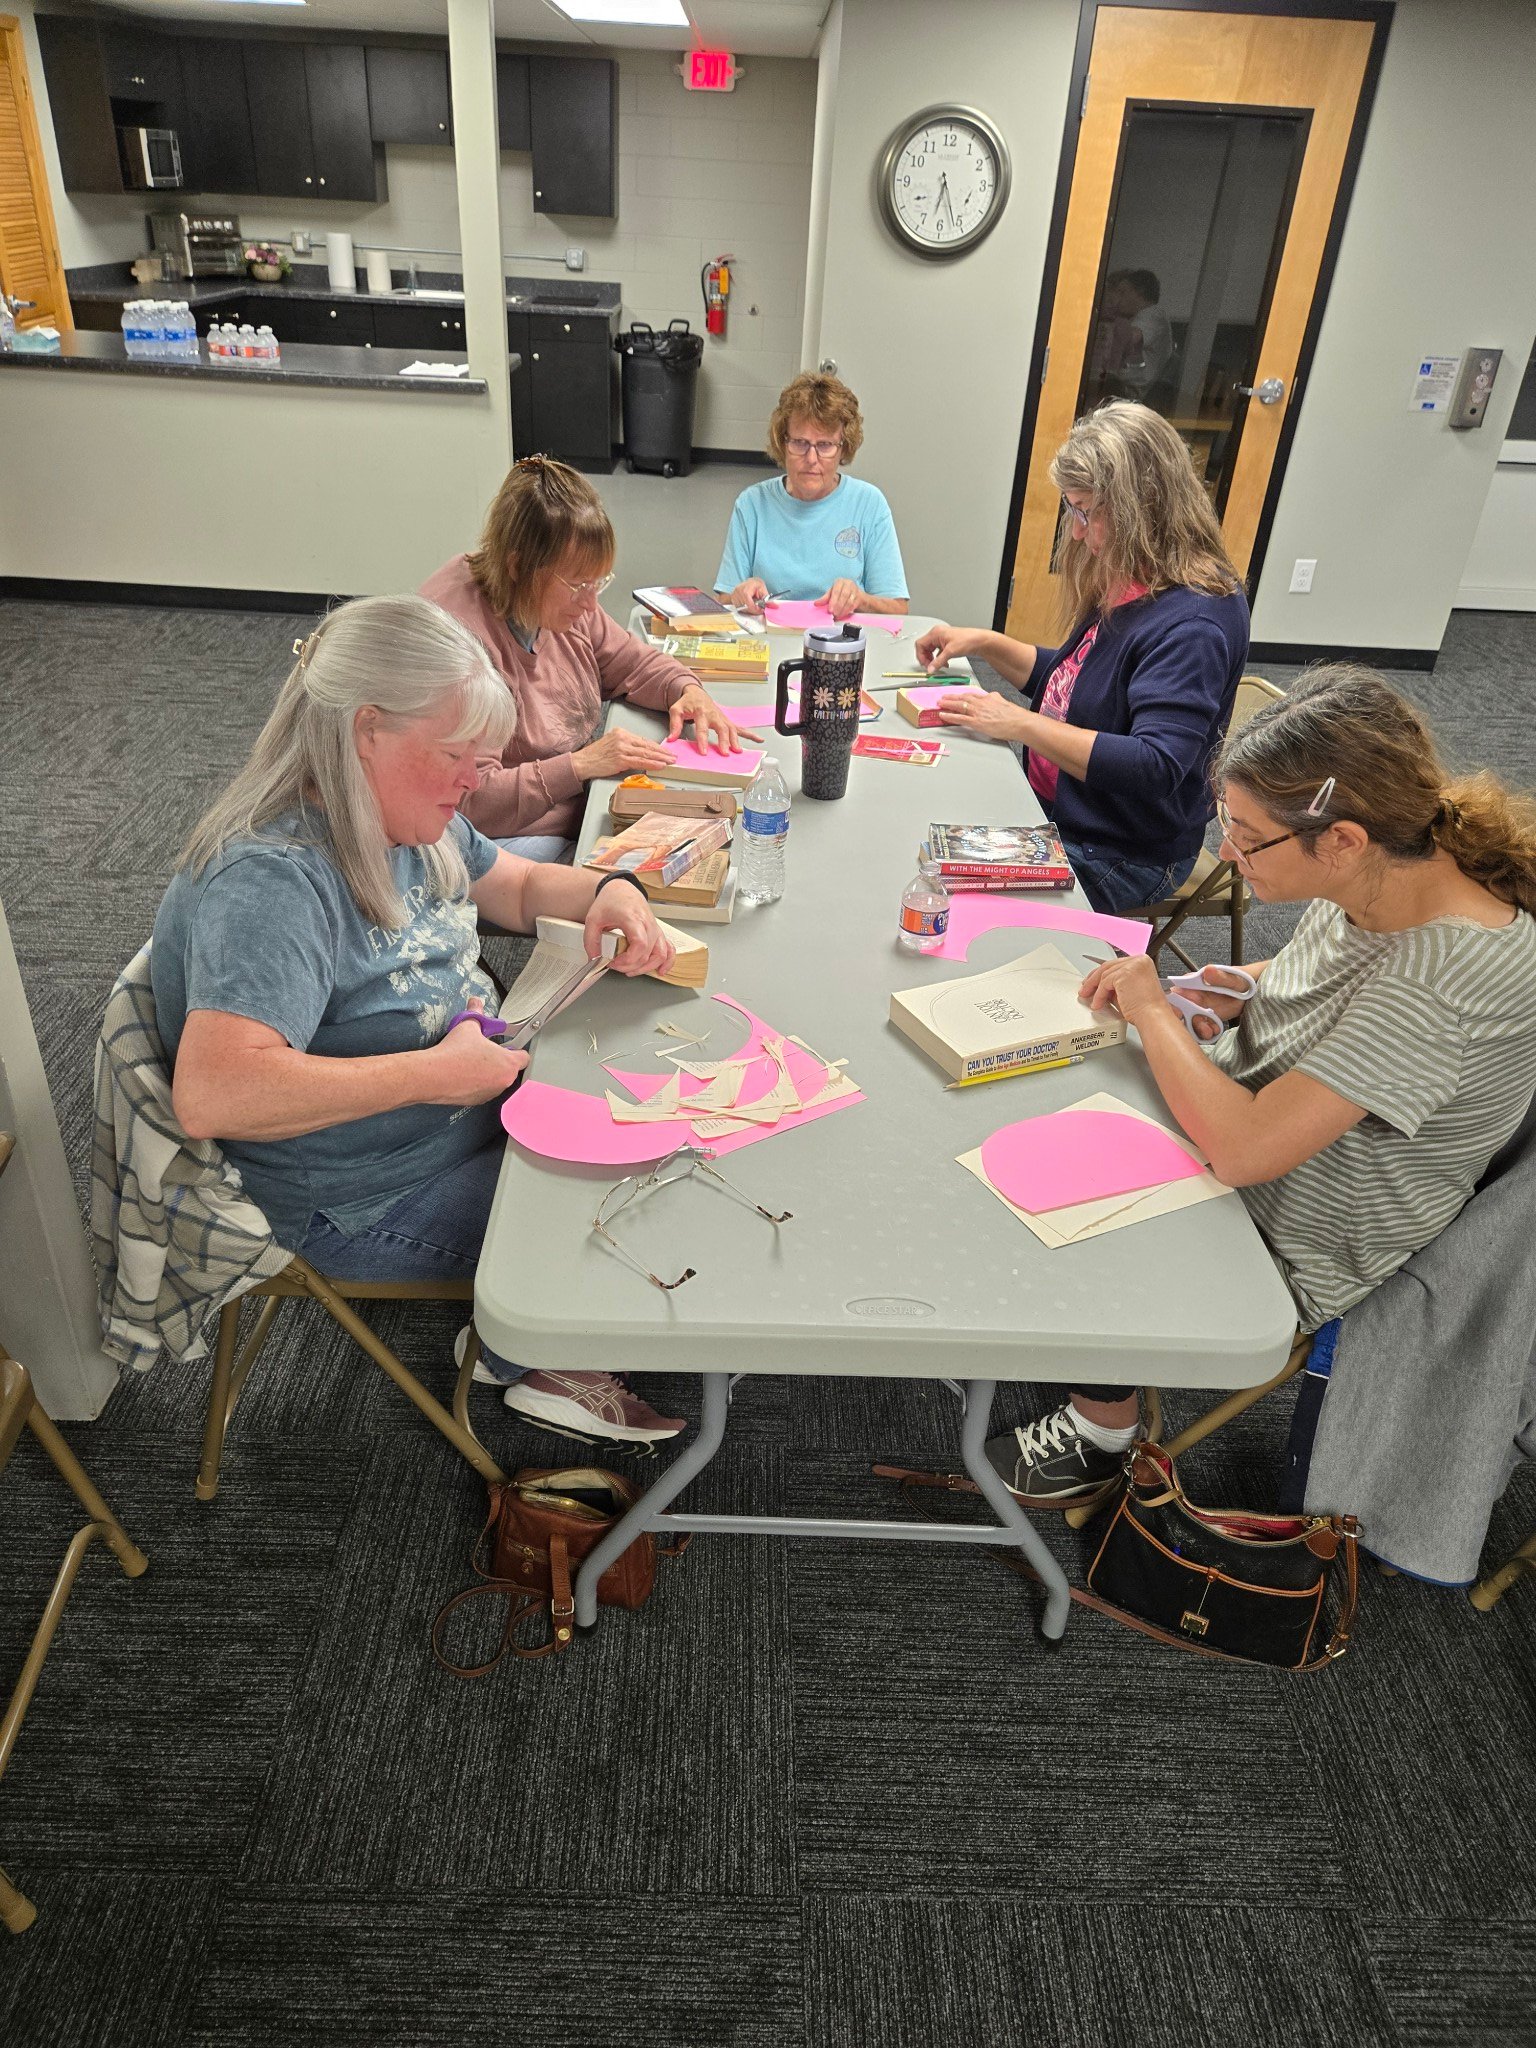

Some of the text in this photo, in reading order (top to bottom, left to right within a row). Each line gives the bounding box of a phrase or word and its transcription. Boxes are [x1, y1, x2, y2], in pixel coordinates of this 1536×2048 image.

[691, 52, 729, 89] EXIT
[923, 141, 936, 153] 11
[943, 134, 957, 147] 12
[966, 143, 972, 156] 1
[910, 154, 925, 168] 10
[975, 158, 984, 172] 2
[902, 174, 911, 188] 9
[979, 179, 987, 193] 3
[920, 212, 928, 226] 7
[936, 219, 944, 232] 6
[955, 214, 963, 228] 5
[813, 709, 836, 721] FAITH
[949, 865, 968, 873] WITH
[969, 865, 983, 873] THE
[983, 866, 1009, 874] MIGHT
[1009, 867, 1020, 875] OF
[1020, 868, 1050, 876] ANGELS
[1070, 1031, 1105, 1044] ANKERBERG
[1075, 1040, 1100, 1051] WELDON
[967, 1040, 1060, 1071] CAN YOU TRUST YOUR DOCTOR?
